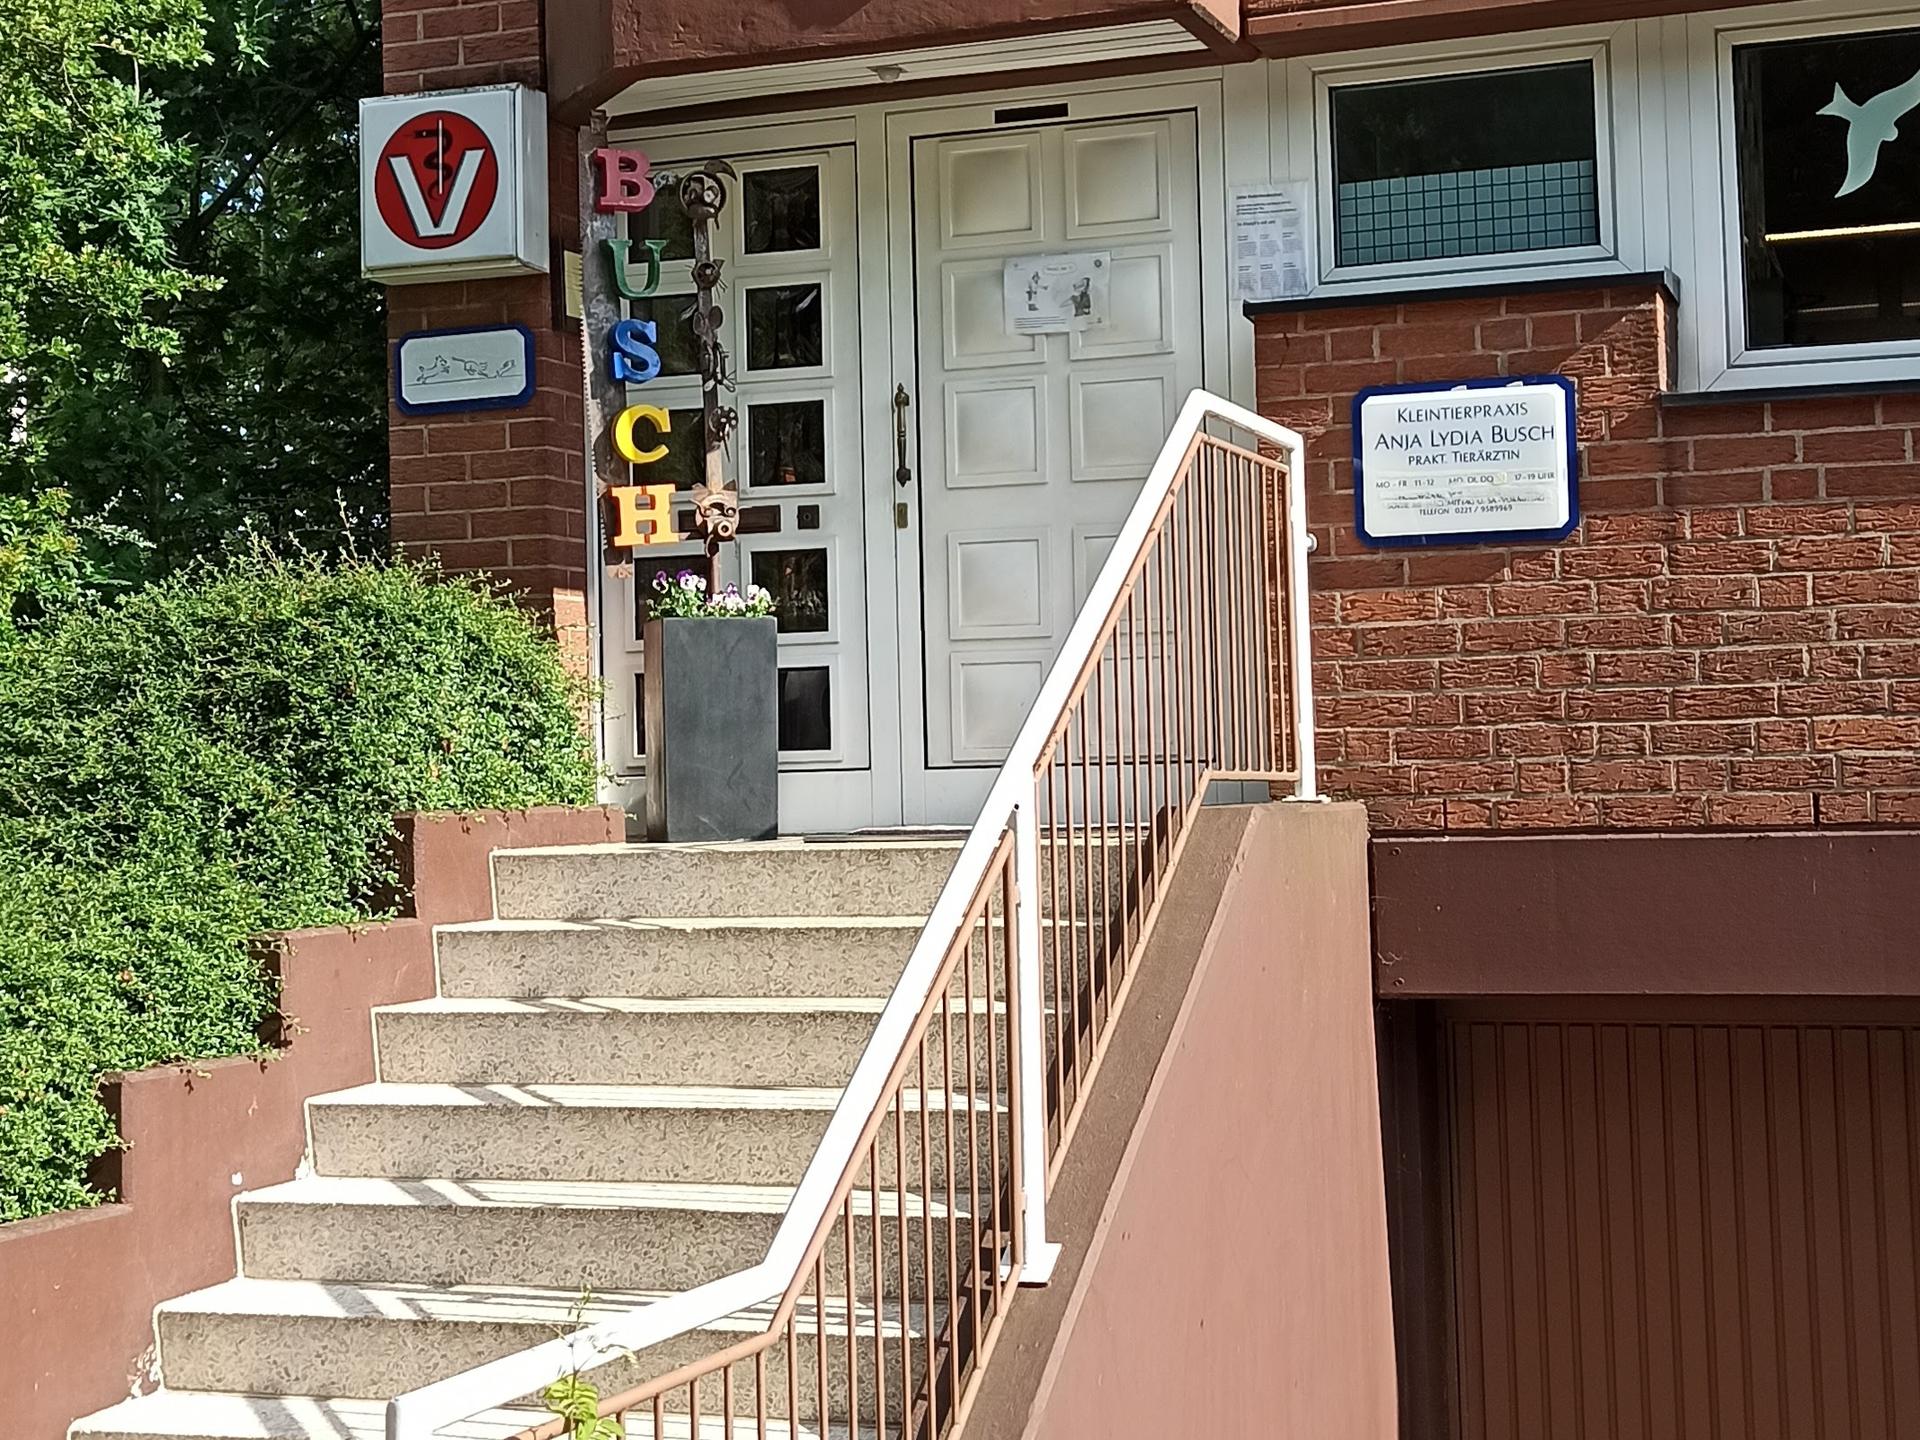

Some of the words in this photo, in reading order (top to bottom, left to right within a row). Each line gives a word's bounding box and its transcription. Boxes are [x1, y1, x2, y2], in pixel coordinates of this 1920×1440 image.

[595, 148, 681, 547] BUSCH
[1397, 402, 1528, 423] KLEINTIERPRAXIS
[1375, 433, 1423, 451] ANJA
[1430, 429, 1483, 447] LYDIA
[1491, 424, 1555, 443] BUSCH
[1451, 449, 1521, 464] TIERÄRZTIN
